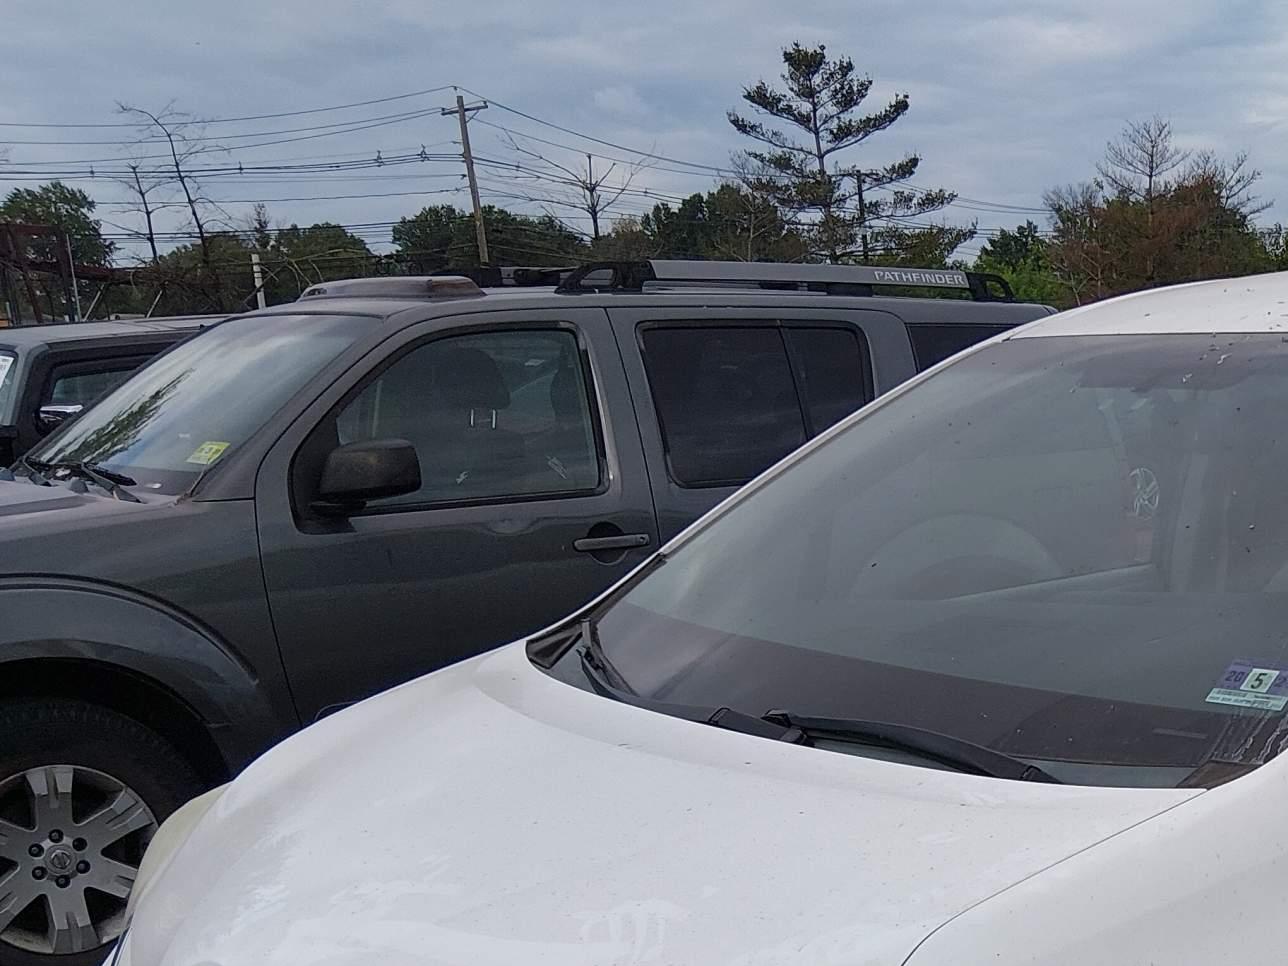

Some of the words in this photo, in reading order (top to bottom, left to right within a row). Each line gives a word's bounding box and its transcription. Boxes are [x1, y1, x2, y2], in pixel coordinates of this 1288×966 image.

[874, 271, 965, 285] PATHFINDER
[1226, 670, 1245, 683] 20
[1250, 673, 1267, 689] 5
